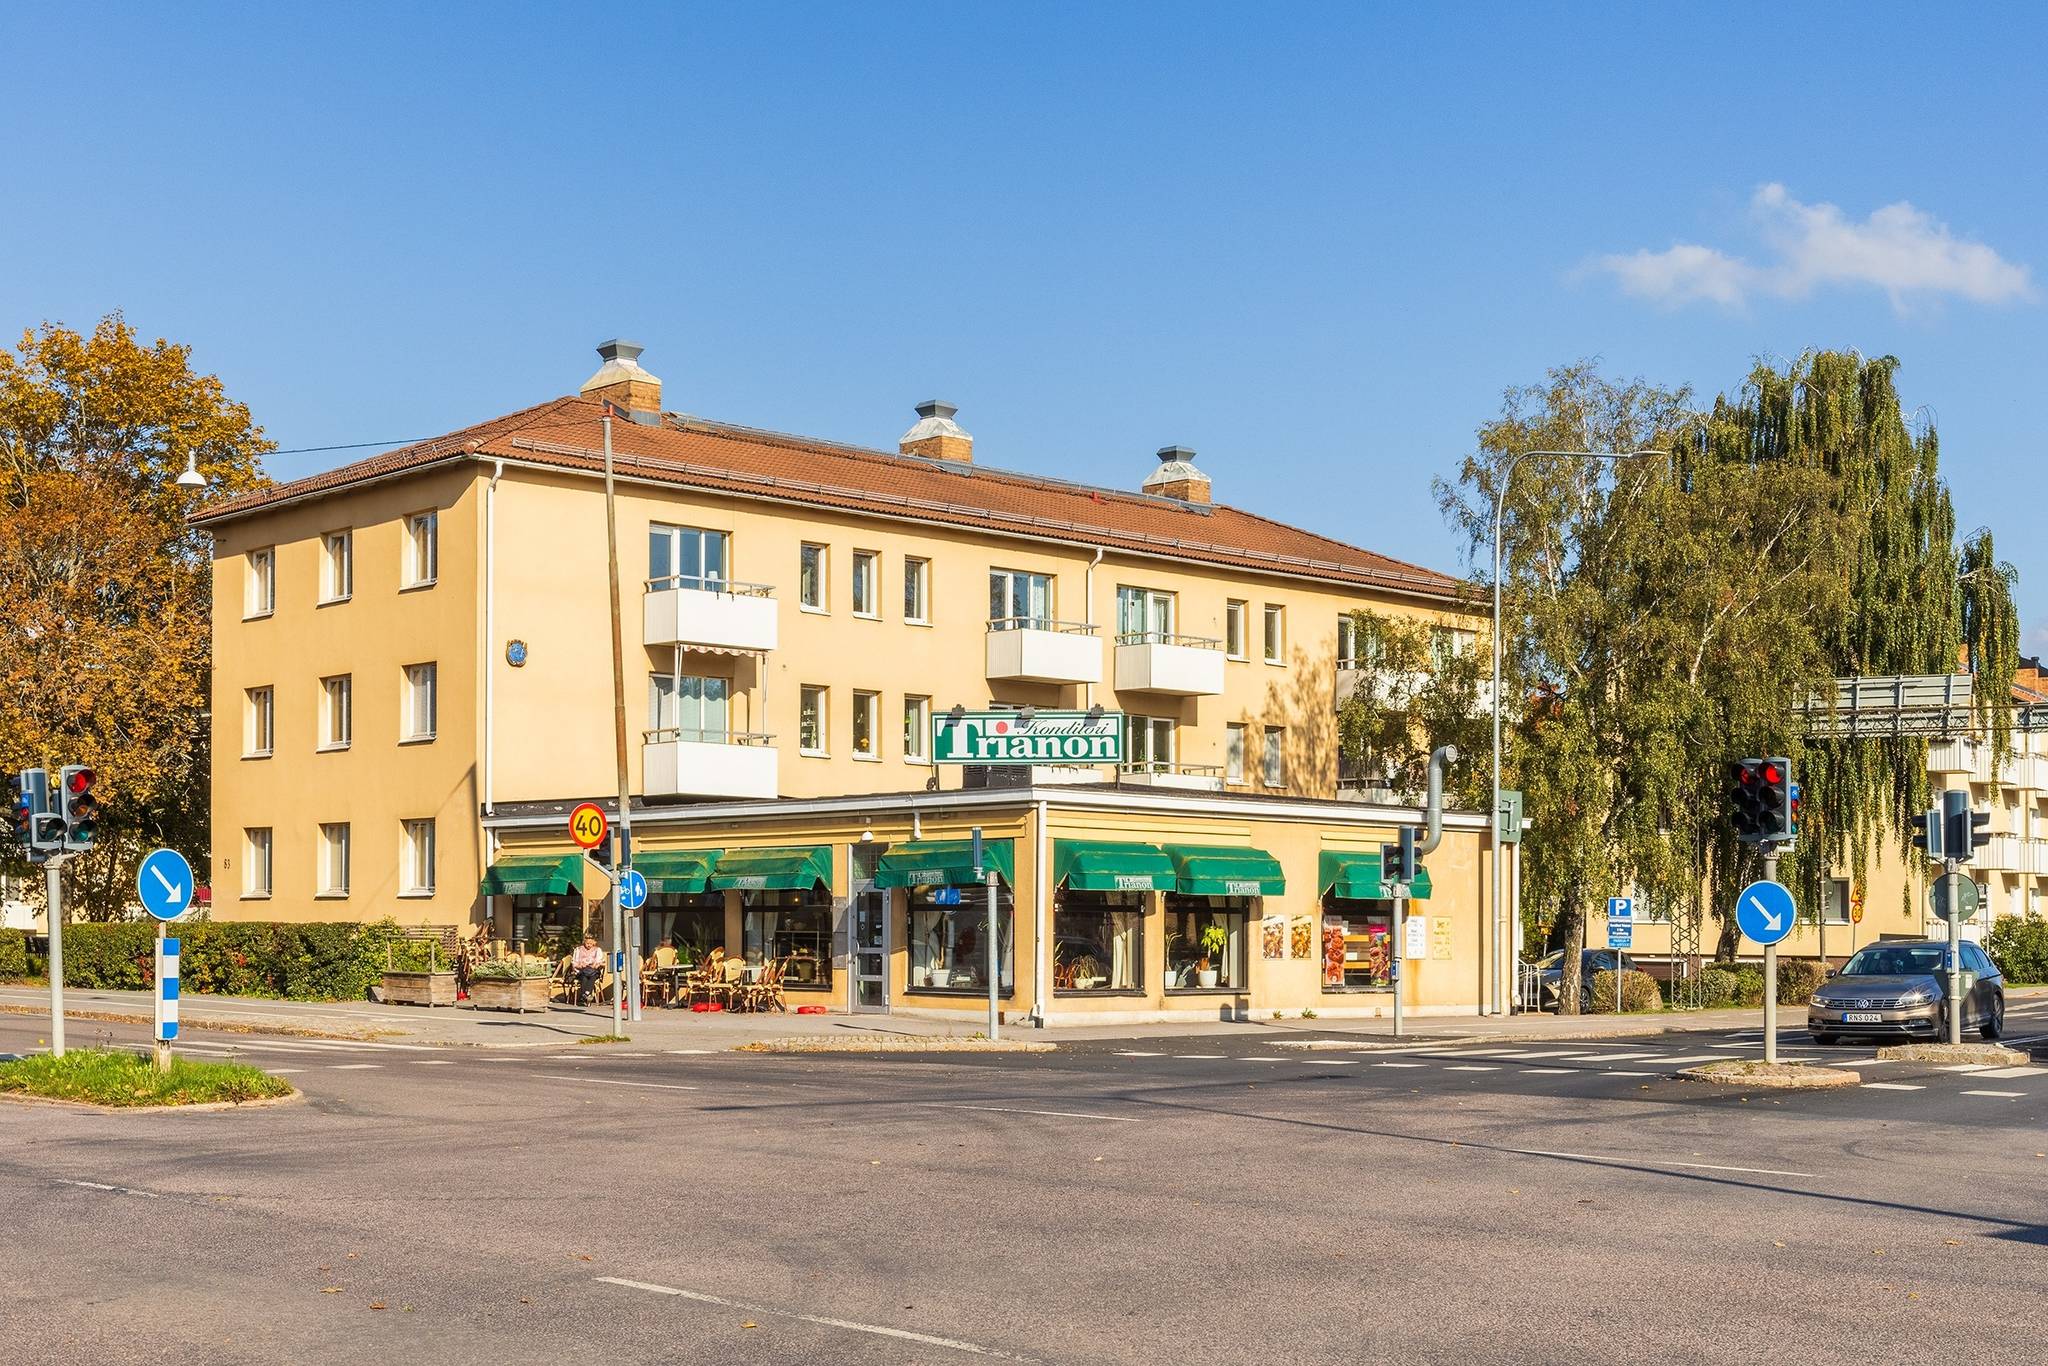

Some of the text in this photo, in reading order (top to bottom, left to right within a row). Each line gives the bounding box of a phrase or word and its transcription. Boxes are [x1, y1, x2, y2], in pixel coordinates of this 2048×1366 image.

[1017, 719, 1109, 734] Konditori
[936, 719, 1118, 759] Trianon
[575, 815, 601, 837] 40
[1115, 876, 1153, 890] Trianon
[1225, 883, 1260, 895] Trianon
[1615, 899, 1628, 916] P
[1848, 1014, 1879, 1022] RNS 024
